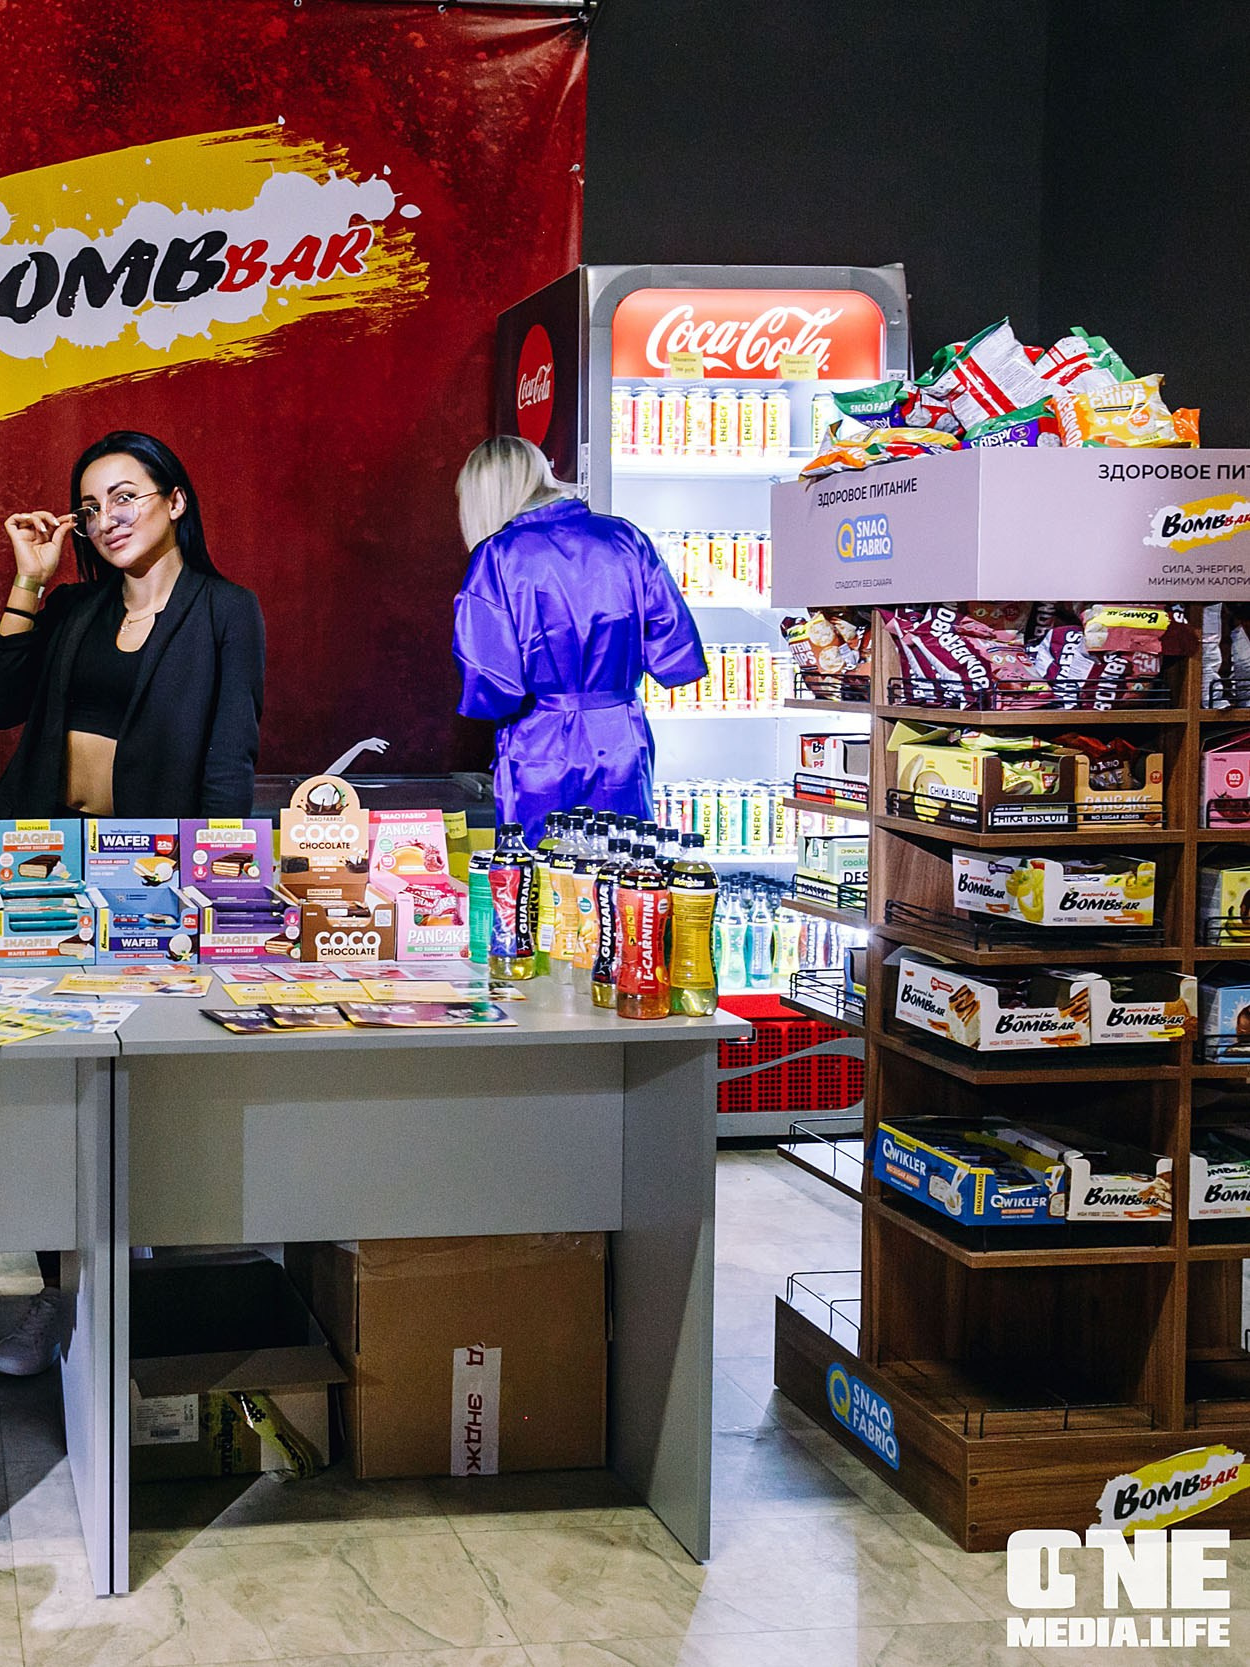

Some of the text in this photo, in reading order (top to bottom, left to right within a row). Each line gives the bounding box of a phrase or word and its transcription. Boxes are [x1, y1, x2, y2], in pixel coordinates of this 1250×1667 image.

[645, 304, 845, 372] Coca-Cola
[1090, 387, 1147, 409] CHIPS
[719, 405, 728, 443] ENERGY
[744, 403, 753, 441] ENERGY
[769, 403, 778, 441] ENERGY
[1098, 464, 1211, 482] ЗДОРОВОЕ
[818, 477, 918, 508] ЗДОРОВОЕ ПИТАНИЕ
[856, 518, 887, 538] SNAQ
[856, 537, 891, 557] FABRIQ
[1162, 565, 1246, 575] СИЛА, ЭНЕРГИЯ,
[1148, 577, 1205, 586] МИНИМУМ
[727, 657, 735, 694] ENERGY
[758, 657, 766, 694] ENERGY
[929, 786, 977, 801] CHIKA BISCUIT
[379, 824, 431, 836] PANCAKE
[704, 803, 712, 840] ENERGY
[720, 803, 729, 841] ENERGY
[753, 804, 762, 841] ENERGY
[775, 801, 784, 838] ENERGY
[4, 833, 63, 844] SNAQFER
[102, 835, 150, 847] WAFER
[198, 831, 255, 842] SNAQFER
[289, 823, 360, 843] COCO
[299, 842, 351, 850] CHOCOLATE
[957, 872, 1006, 899] BOMBBAR
[519, 866, 532, 934] GUARANA
[1059, 890, 1141, 911] BOMBBAR
[599, 882, 611, 958] GUARANA
[121, 938, 159, 948] WAFER
[314, 931, 382, 949] COCO
[407, 929, 470, 944] PANCAKE
[641, 892, 655, 981] L-CARNITINE
[320, 947, 376, 956] CHOCOLATE
[901, 983, 947, 1017] BOMBBAR
[995, 1013, 1076, 1034] BOMBBAR
[1105, 1007, 1185, 1028] BOMBBAR
[882, 1138, 927, 1177] QWIKLER
[990, 1194, 1047, 1208] QWIKLER
[1083, 1187, 1160, 1206] BOMBBAR
[852, 1383, 894, 1431] SNAQ
[852, 1412, 898, 1462] FABRIQ
[1114, 1465, 1240, 1521] BOMBBAR
